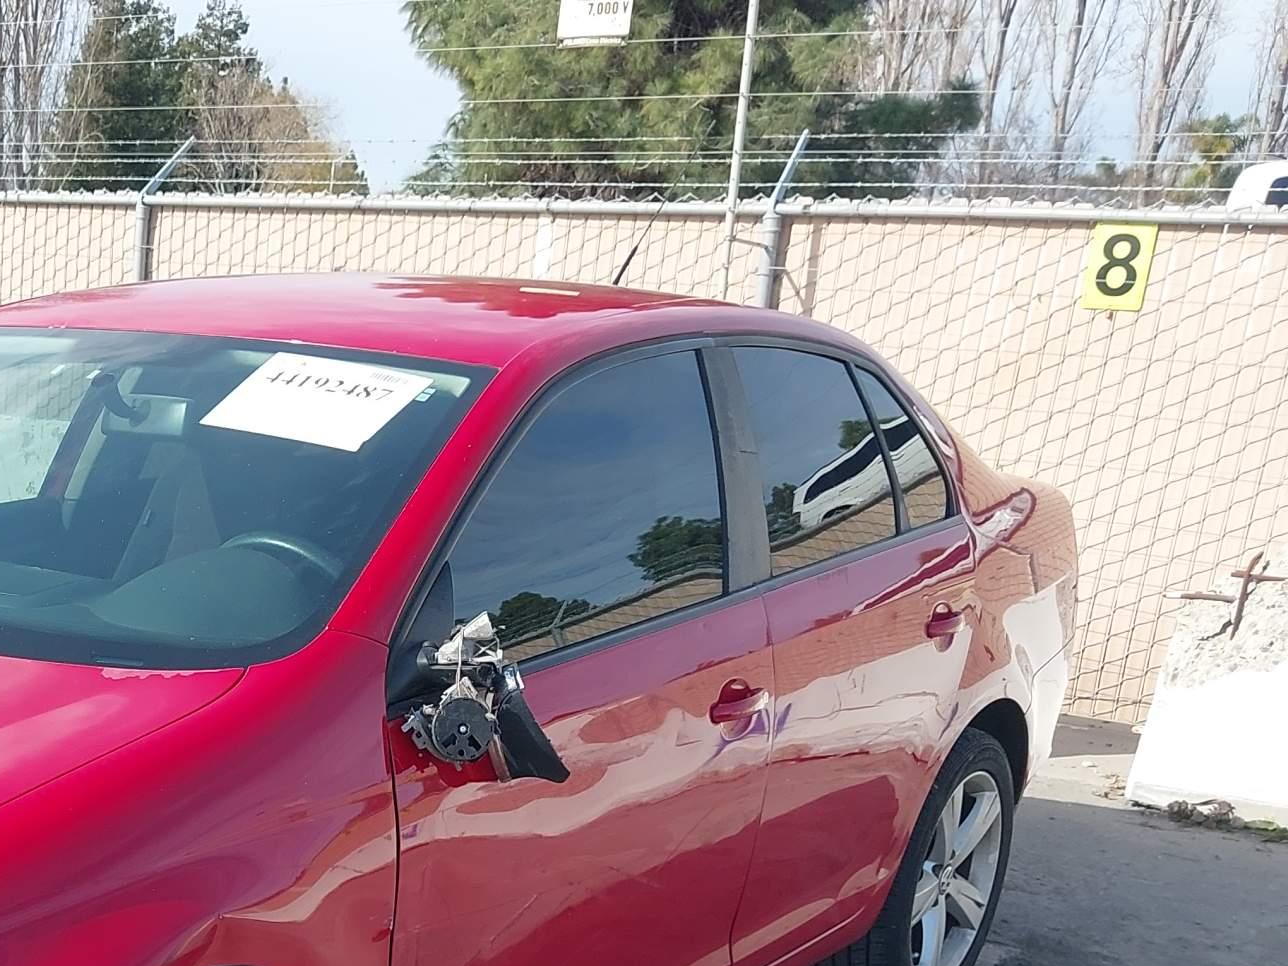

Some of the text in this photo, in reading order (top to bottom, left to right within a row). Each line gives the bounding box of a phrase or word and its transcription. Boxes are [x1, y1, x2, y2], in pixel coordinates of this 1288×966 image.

[588, 1, 629, 16] 7,000 V
[1096, 234, 1141, 296] 8
[266, 371, 394, 401] 44192487
